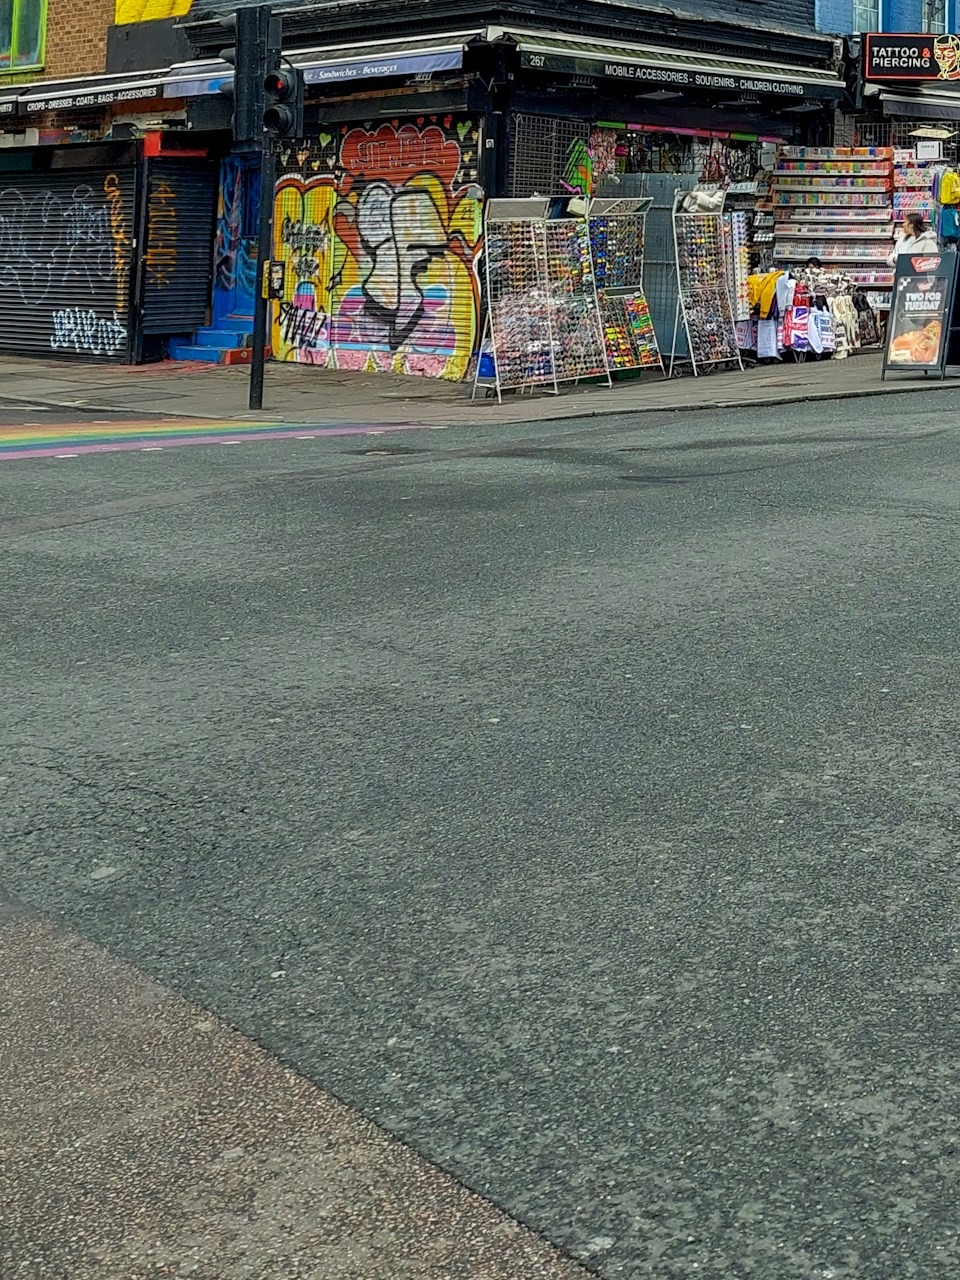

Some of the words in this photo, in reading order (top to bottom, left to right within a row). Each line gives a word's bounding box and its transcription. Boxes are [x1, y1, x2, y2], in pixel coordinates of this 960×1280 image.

[871, 46, 919, 58] TATTOO
[921, 47, 932, 58] &
[872, 57, 931, 68] PIERCING
[318, 68, 357, 80] Sandwiches
[362, 64, 398, 76] Beverages
[529, 54, 545, 67] 267
[604, 64, 635, 78] MOBILE
[635, 67, 689, 84] ACCESSORIES
[695, 74, 736, 88] SOUVENIRS
[739, 79, 772, 92] CHILDREN
[772, 83, 804, 95] CLOTHING
[26, 100, 46, 112] CROPS
[48, 98, 74, 109] DRESSES
[76, 95, 95, 107] COATS
[97, 93, 115, 104] BAGS
[117, 87, 157, 100] ACCESSORIES
[905, 292, 925, 301] TWO
[925, 291, 942, 301] FOR
[904, 300, 941, 311] TUESDAY
